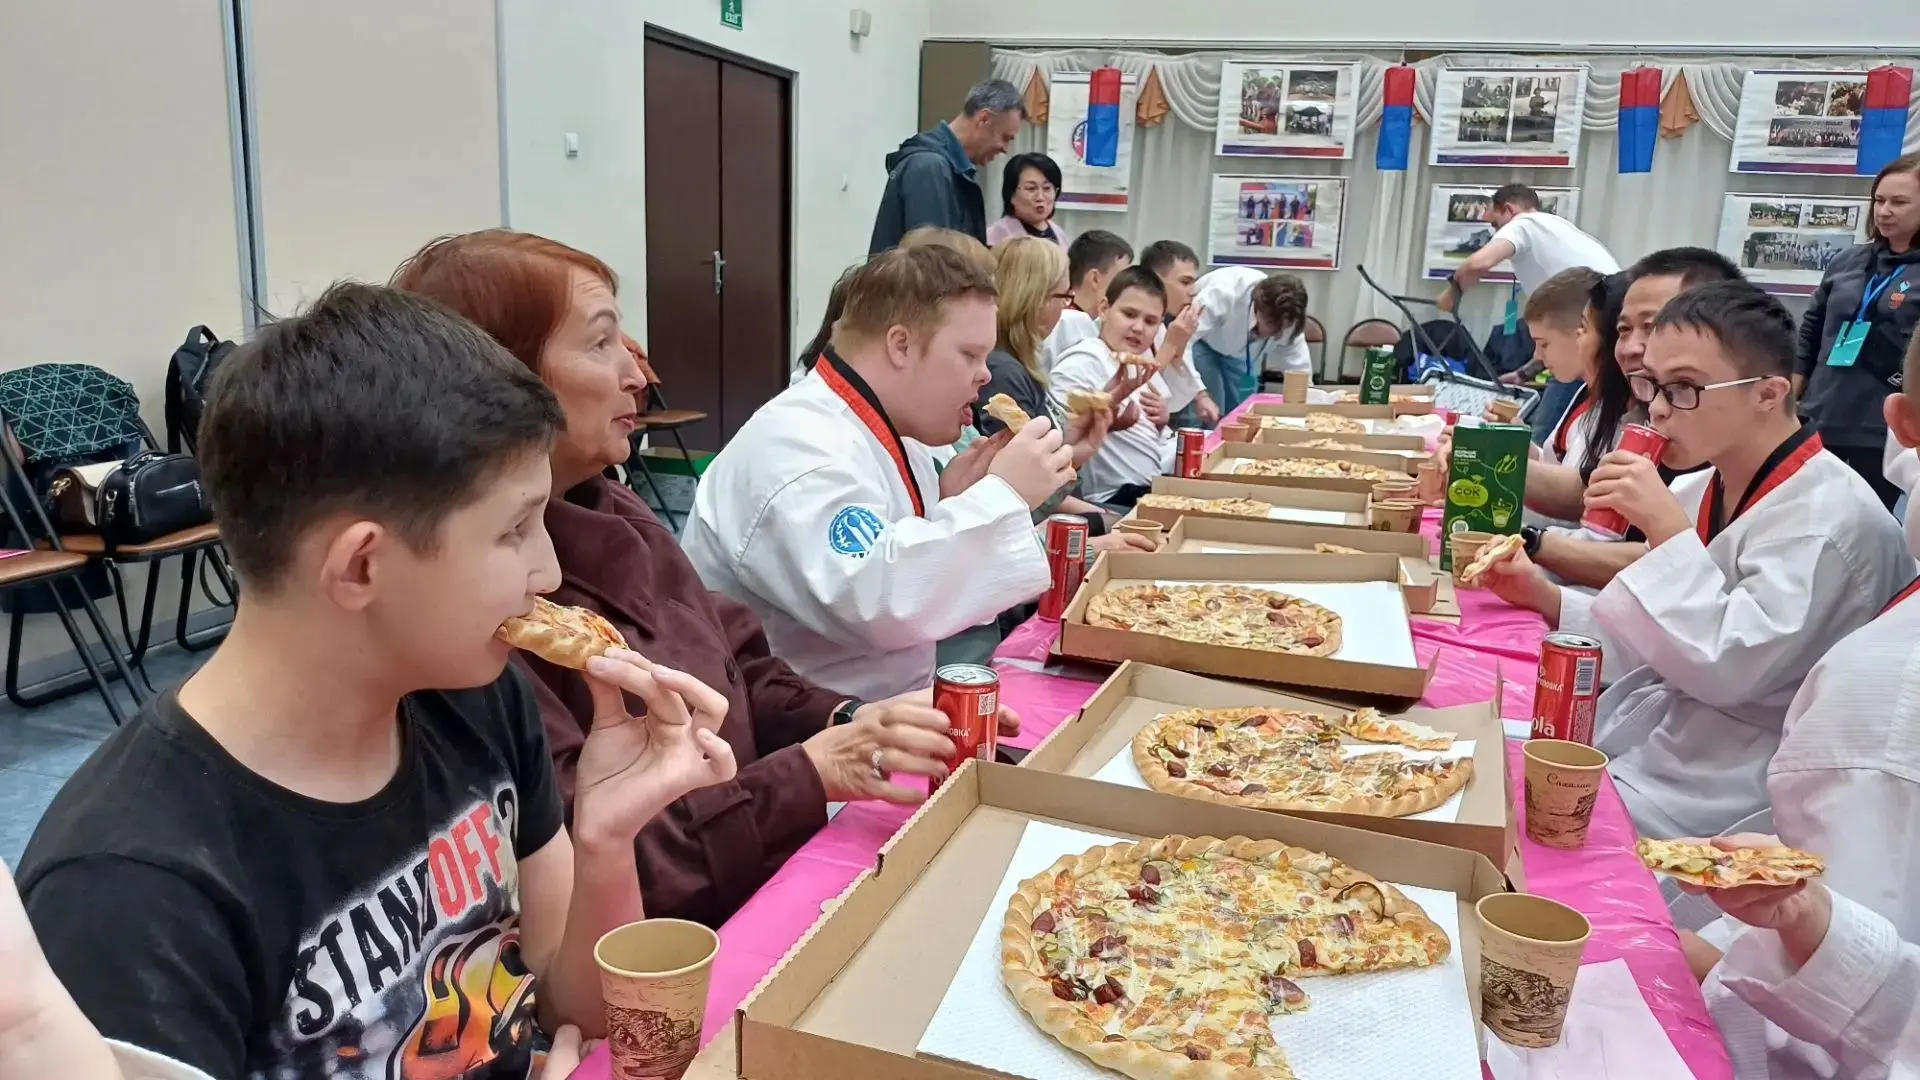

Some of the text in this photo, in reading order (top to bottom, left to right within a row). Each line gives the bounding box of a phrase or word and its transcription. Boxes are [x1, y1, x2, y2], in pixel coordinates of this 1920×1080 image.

[1454, 487, 1481, 497] СОК
[1532, 715, 1556, 738] ola
[293, 800, 503, 1036] STANDOFF
